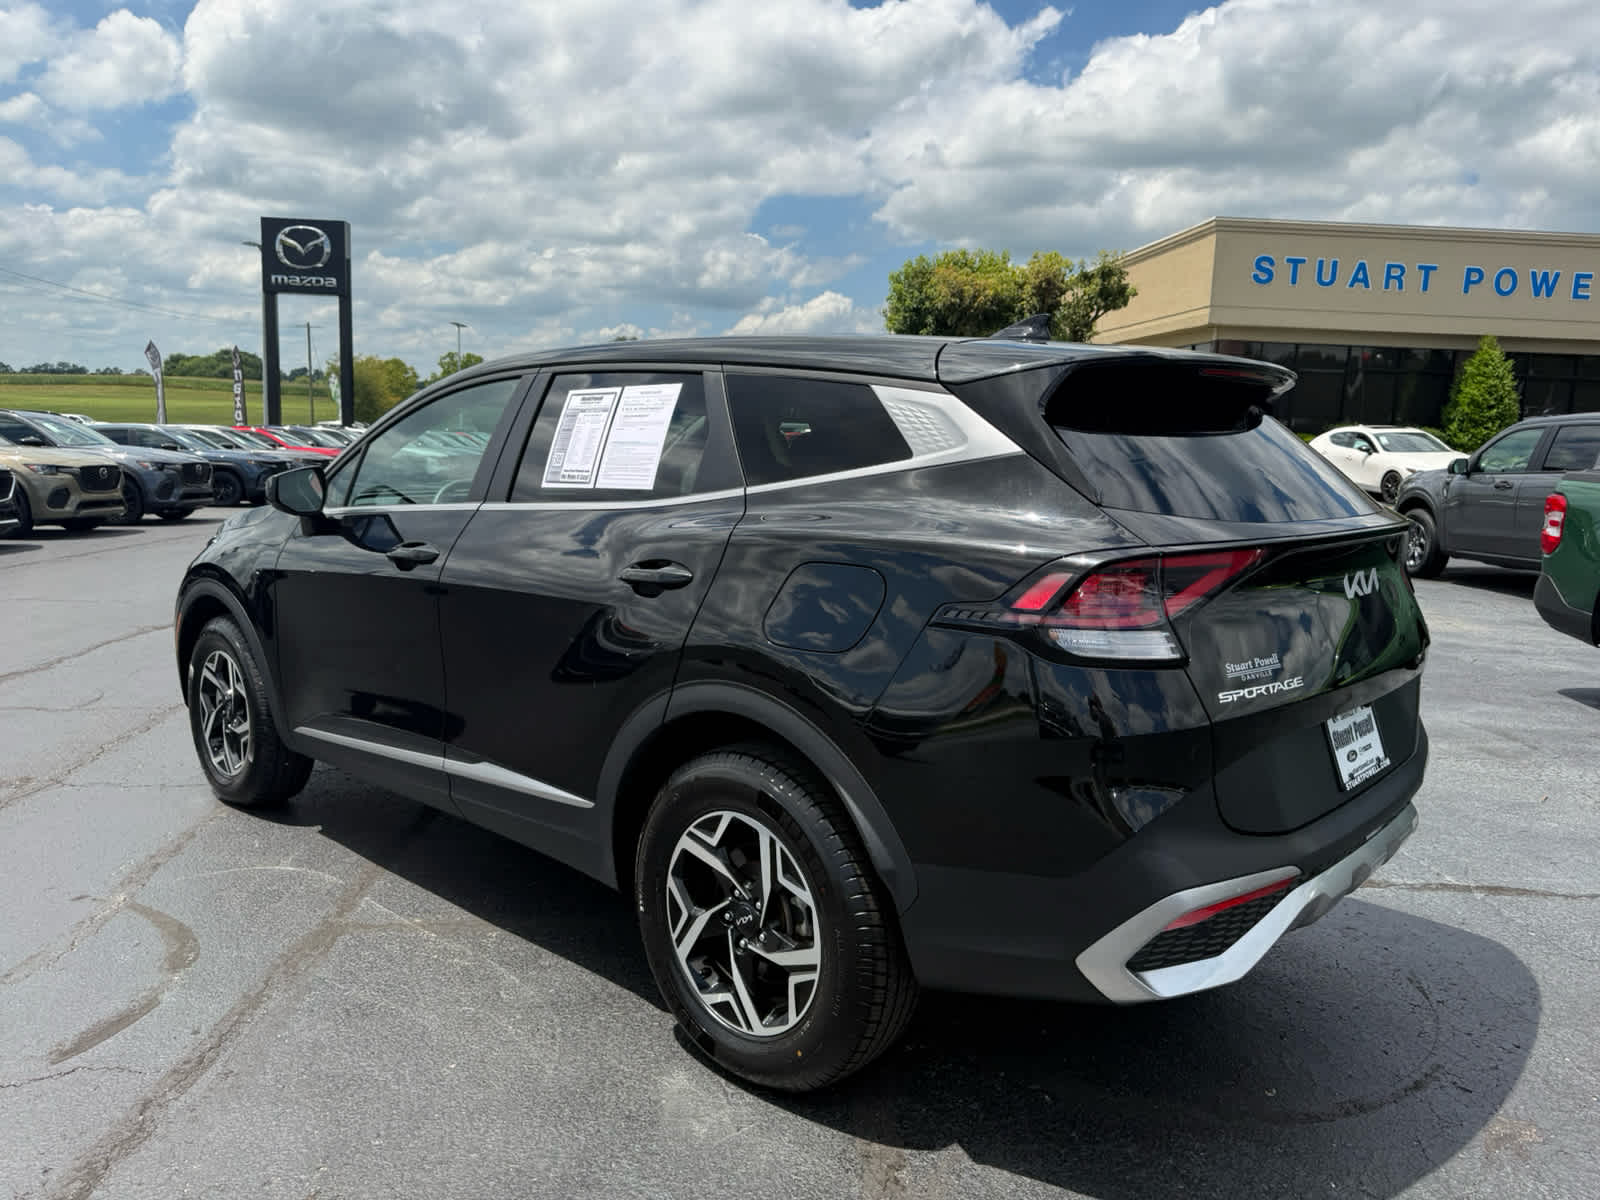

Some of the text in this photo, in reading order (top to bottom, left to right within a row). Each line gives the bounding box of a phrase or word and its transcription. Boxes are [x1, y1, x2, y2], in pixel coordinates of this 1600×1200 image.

[271, 273, 337, 288] mazda
[1252, 254, 1594, 301] STUART POWE
[1343, 567, 1380, 600] KIA
[1225, 653, 1280, 674] Stuart Powell
[1241, 669, 1273, 682] DANVILLE
[1217, 676, 1305, 704] SPORTAGE
